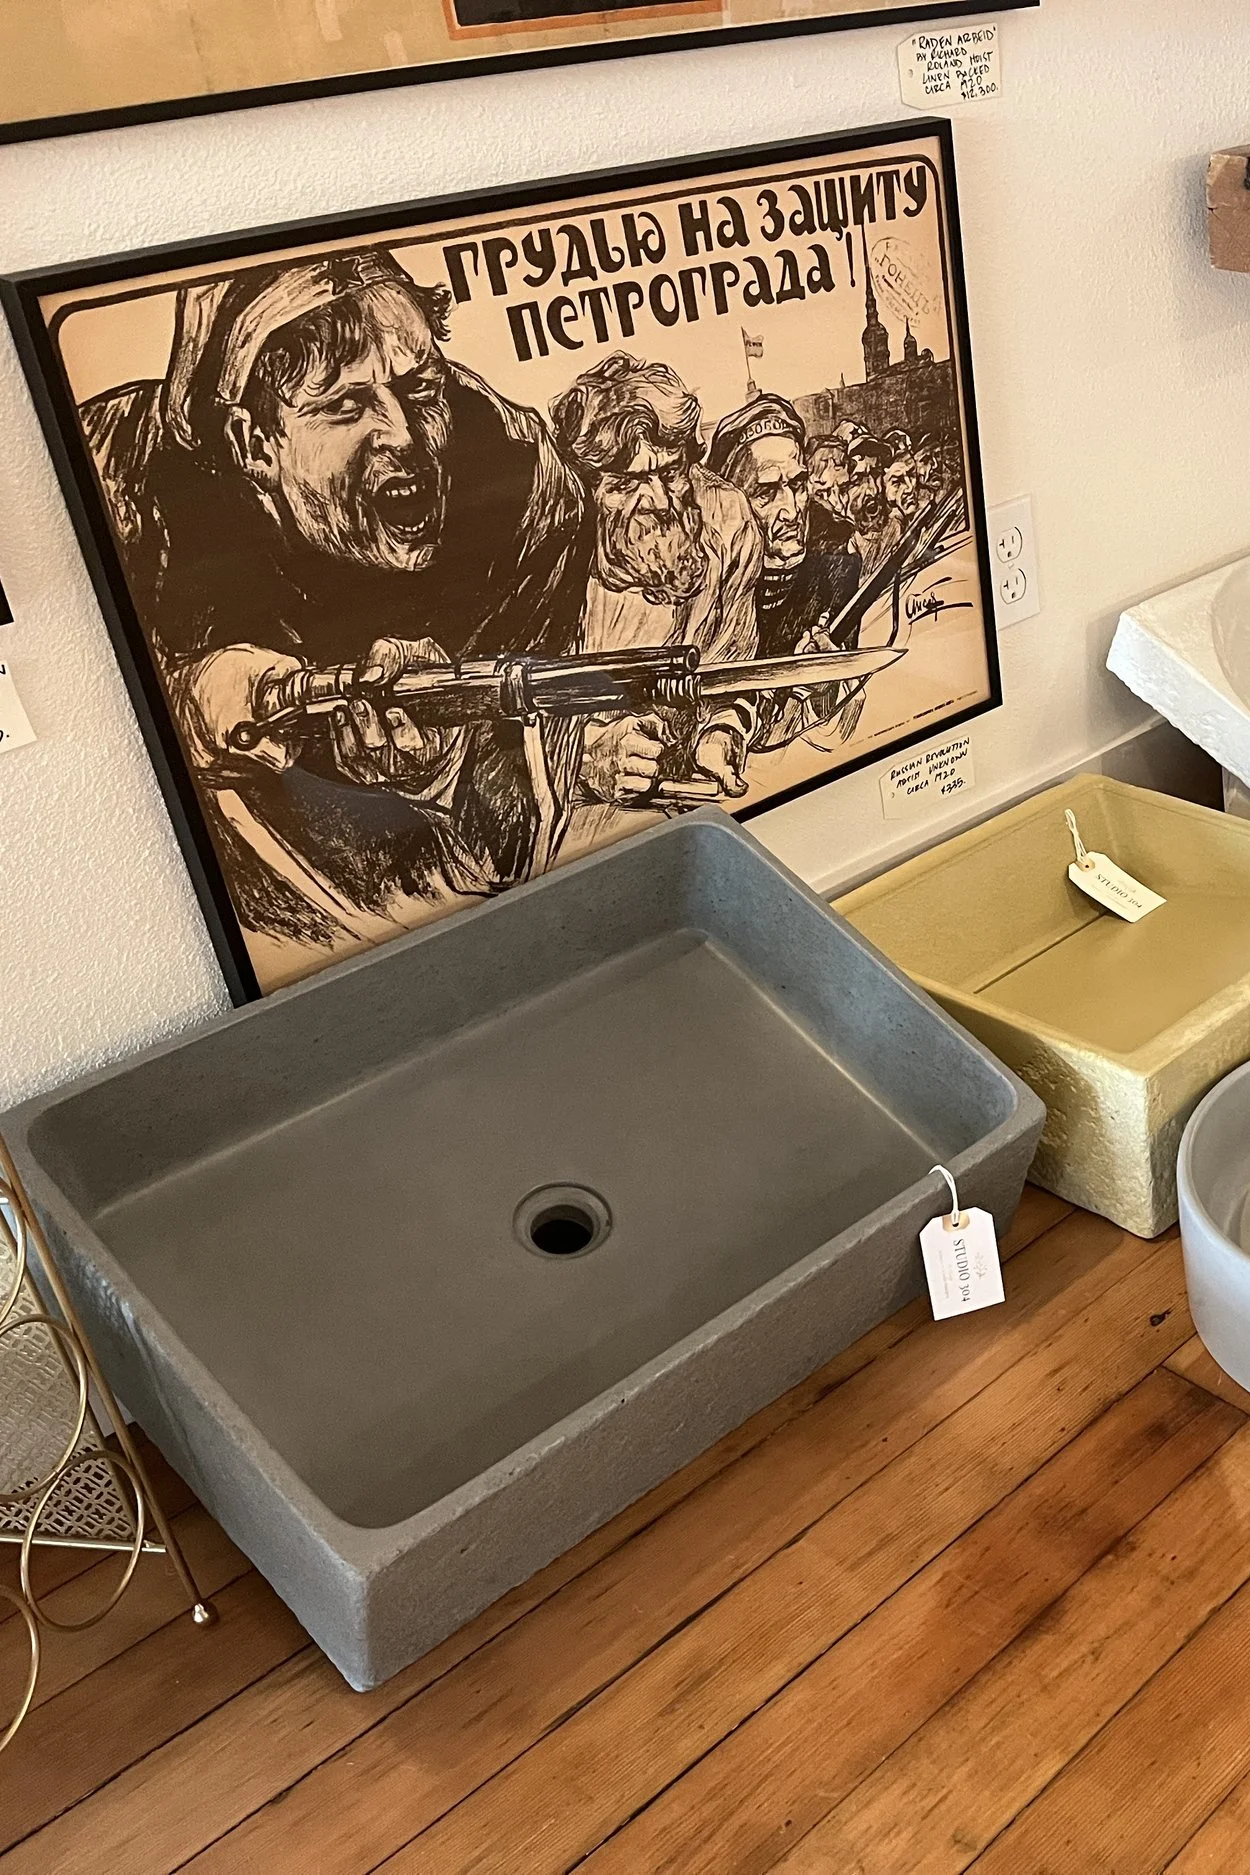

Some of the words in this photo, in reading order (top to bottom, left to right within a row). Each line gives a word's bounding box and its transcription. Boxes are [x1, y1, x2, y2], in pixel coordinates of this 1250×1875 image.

[916, 52, 926, 62] BY
[930, 47, 968, 61] RICHARD
[922, 72, 950, 85] LINEN
[956, 64, 990, 79] BACKED
[927, 60, 962, 72] ROLAND
[925, 80, 951, 95] CIRCA
[890, 758, 923, 781] RUSSIAN
[925, 737, 970, 764] REVOLUTION
[896, 771, 921, 788] ARTIST
[928, 748, 968, 775] UNKNOWN
[906, 779, 929, 795] CIRCA
[1096, 873, 1128, 899] STUDIO
[953, 1238, 971, 1281] STUDIO
[959, 1283, 972, 1302] 304
